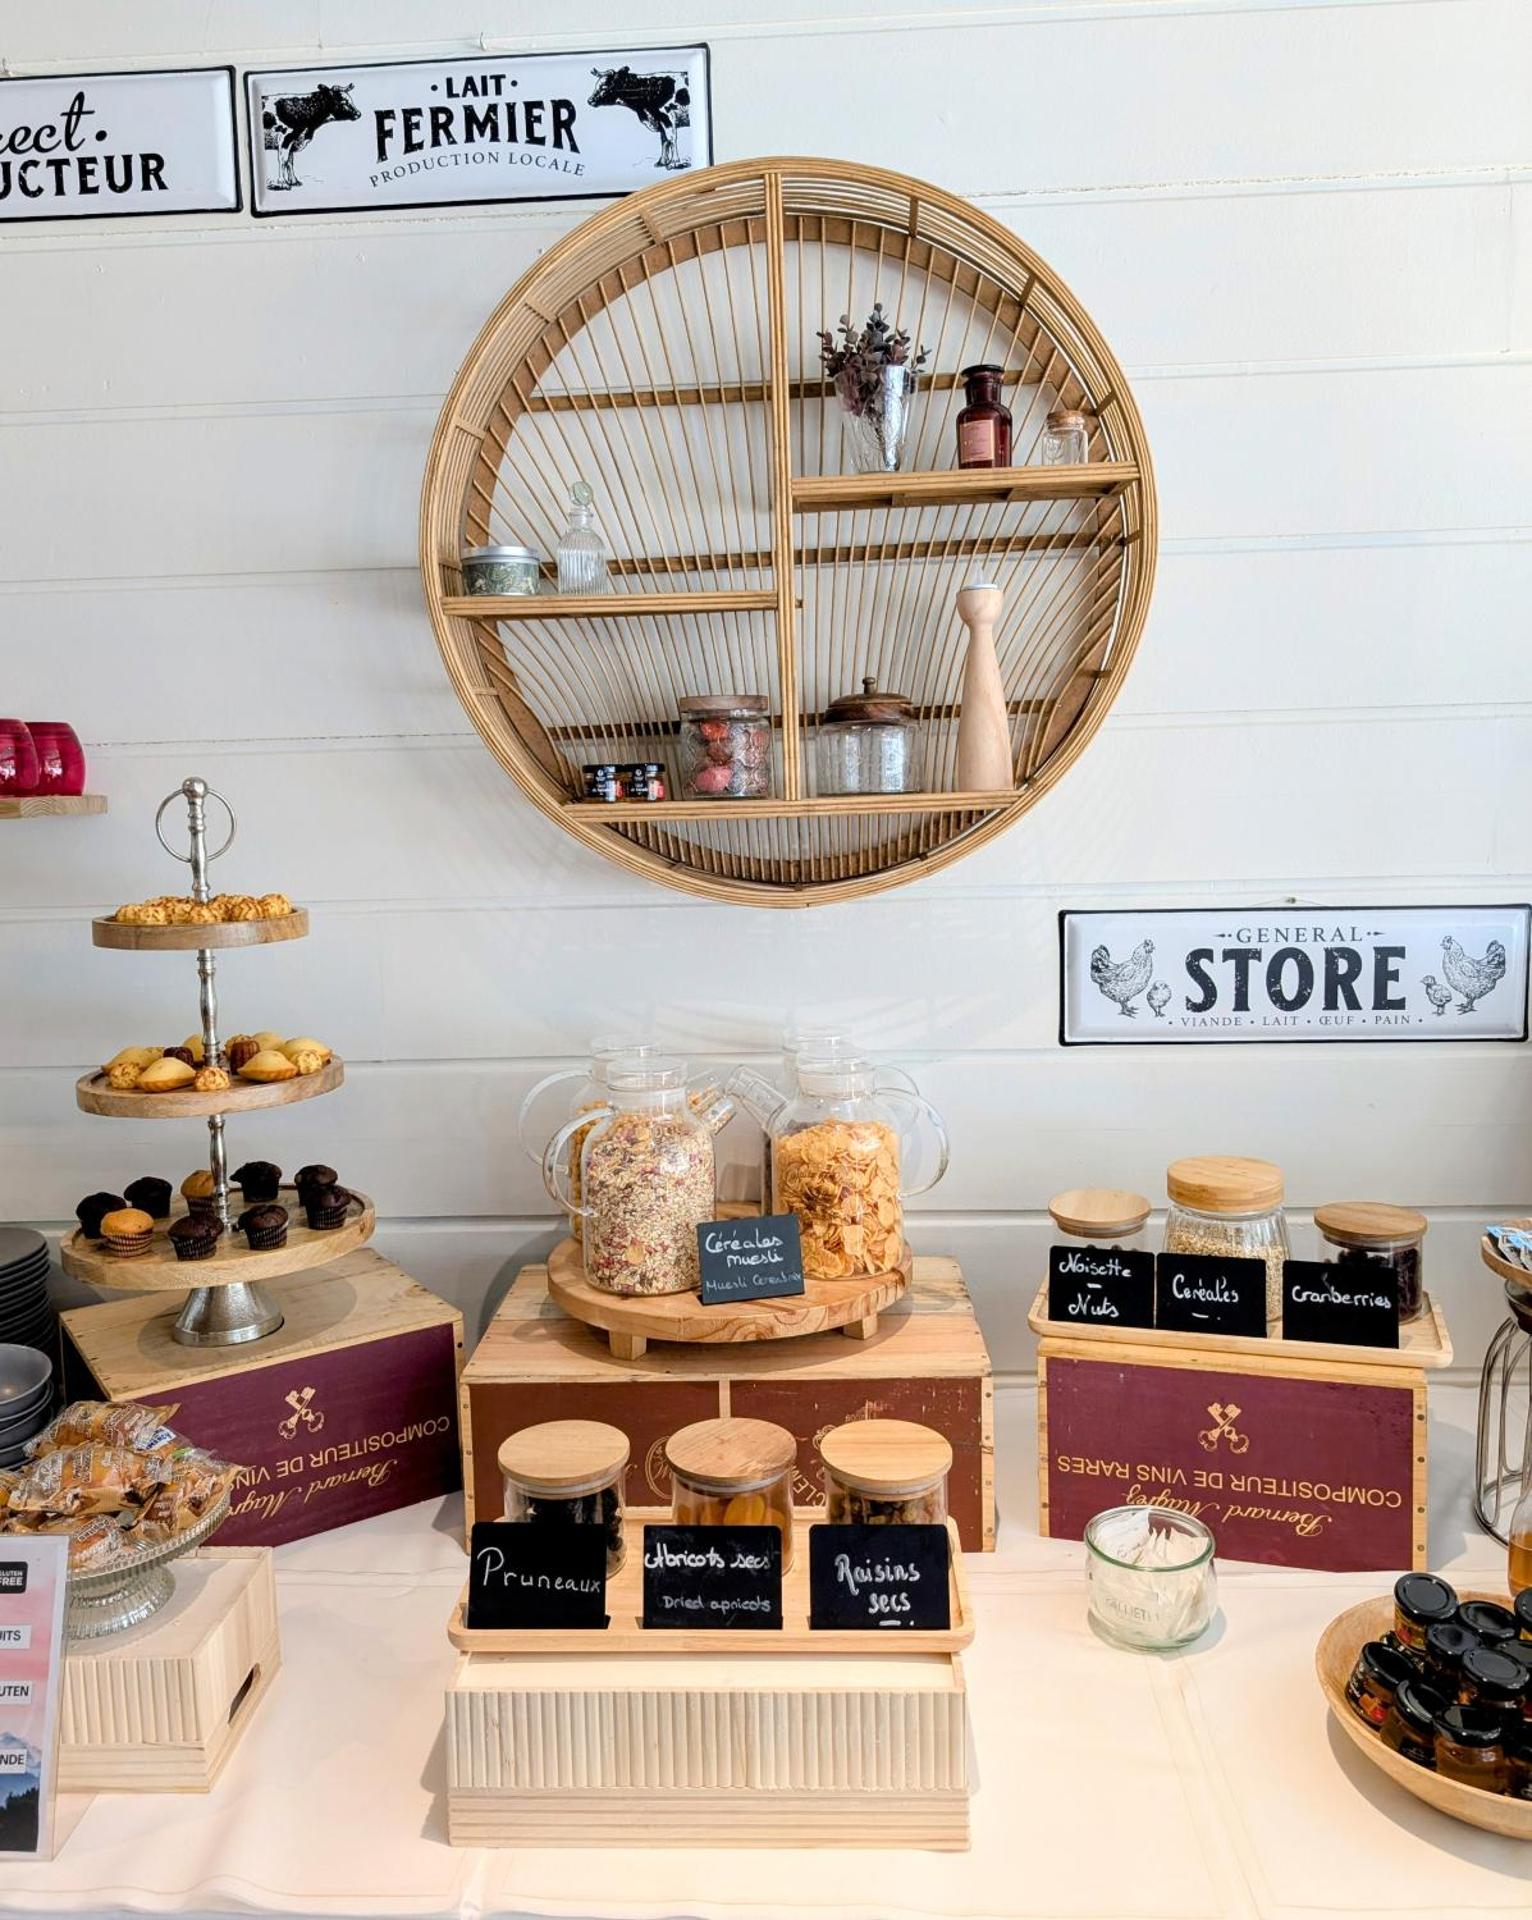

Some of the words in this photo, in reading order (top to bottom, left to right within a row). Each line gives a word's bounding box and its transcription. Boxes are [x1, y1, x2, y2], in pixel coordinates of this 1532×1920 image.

[446, 74, 507, 99] LAIT
[0, 91, 95, 154] ect
[374, 99, 581, 164] FERMIER
[369, 151, 500, 187] PRODUCTION
[508, 152, 586, 176] LOCALE
[1236, 926, 1364, 943] GENERAL
[1185, 946, 1407, 1013] STORE
[1181, 1015, 1243, 1027] VIANDE
[1262, 1015, 1299, 1026] LAIT
[1374, 1014, 1411, 1025] PAIN
[1059, 1252, 1132, 1277] Noisette
[1068, 1292, 1120, 1318] Nuts
[1291, 1283, 1392, 1309] Cranberries
[309, 1416, 450, 1468] COMPOSITEUR
[230, 1464, 271, 1491] VIN
[276, 1456, 304, 1478] DE
[1057, 1455, 1130, 1479] RARES
[1136, 1464, 1187, 1486] VINS
[1194, 1469, 1224, 1489] DE
[303, 1458, 398, 1503] Bernard
[1230, 1473, 1403, 1508] COMPOSITEUR
[1222, 1503, 1333, 1537] Bernard
[476, 1546, 601, 1593] Pruneaux
[834, 1553, 920, 1596] Raisins
[662, 1595, 705, 1610] Dried
[868, 1592, 911, 1614] secs
[0, 1630, 22, 1641] ITS
